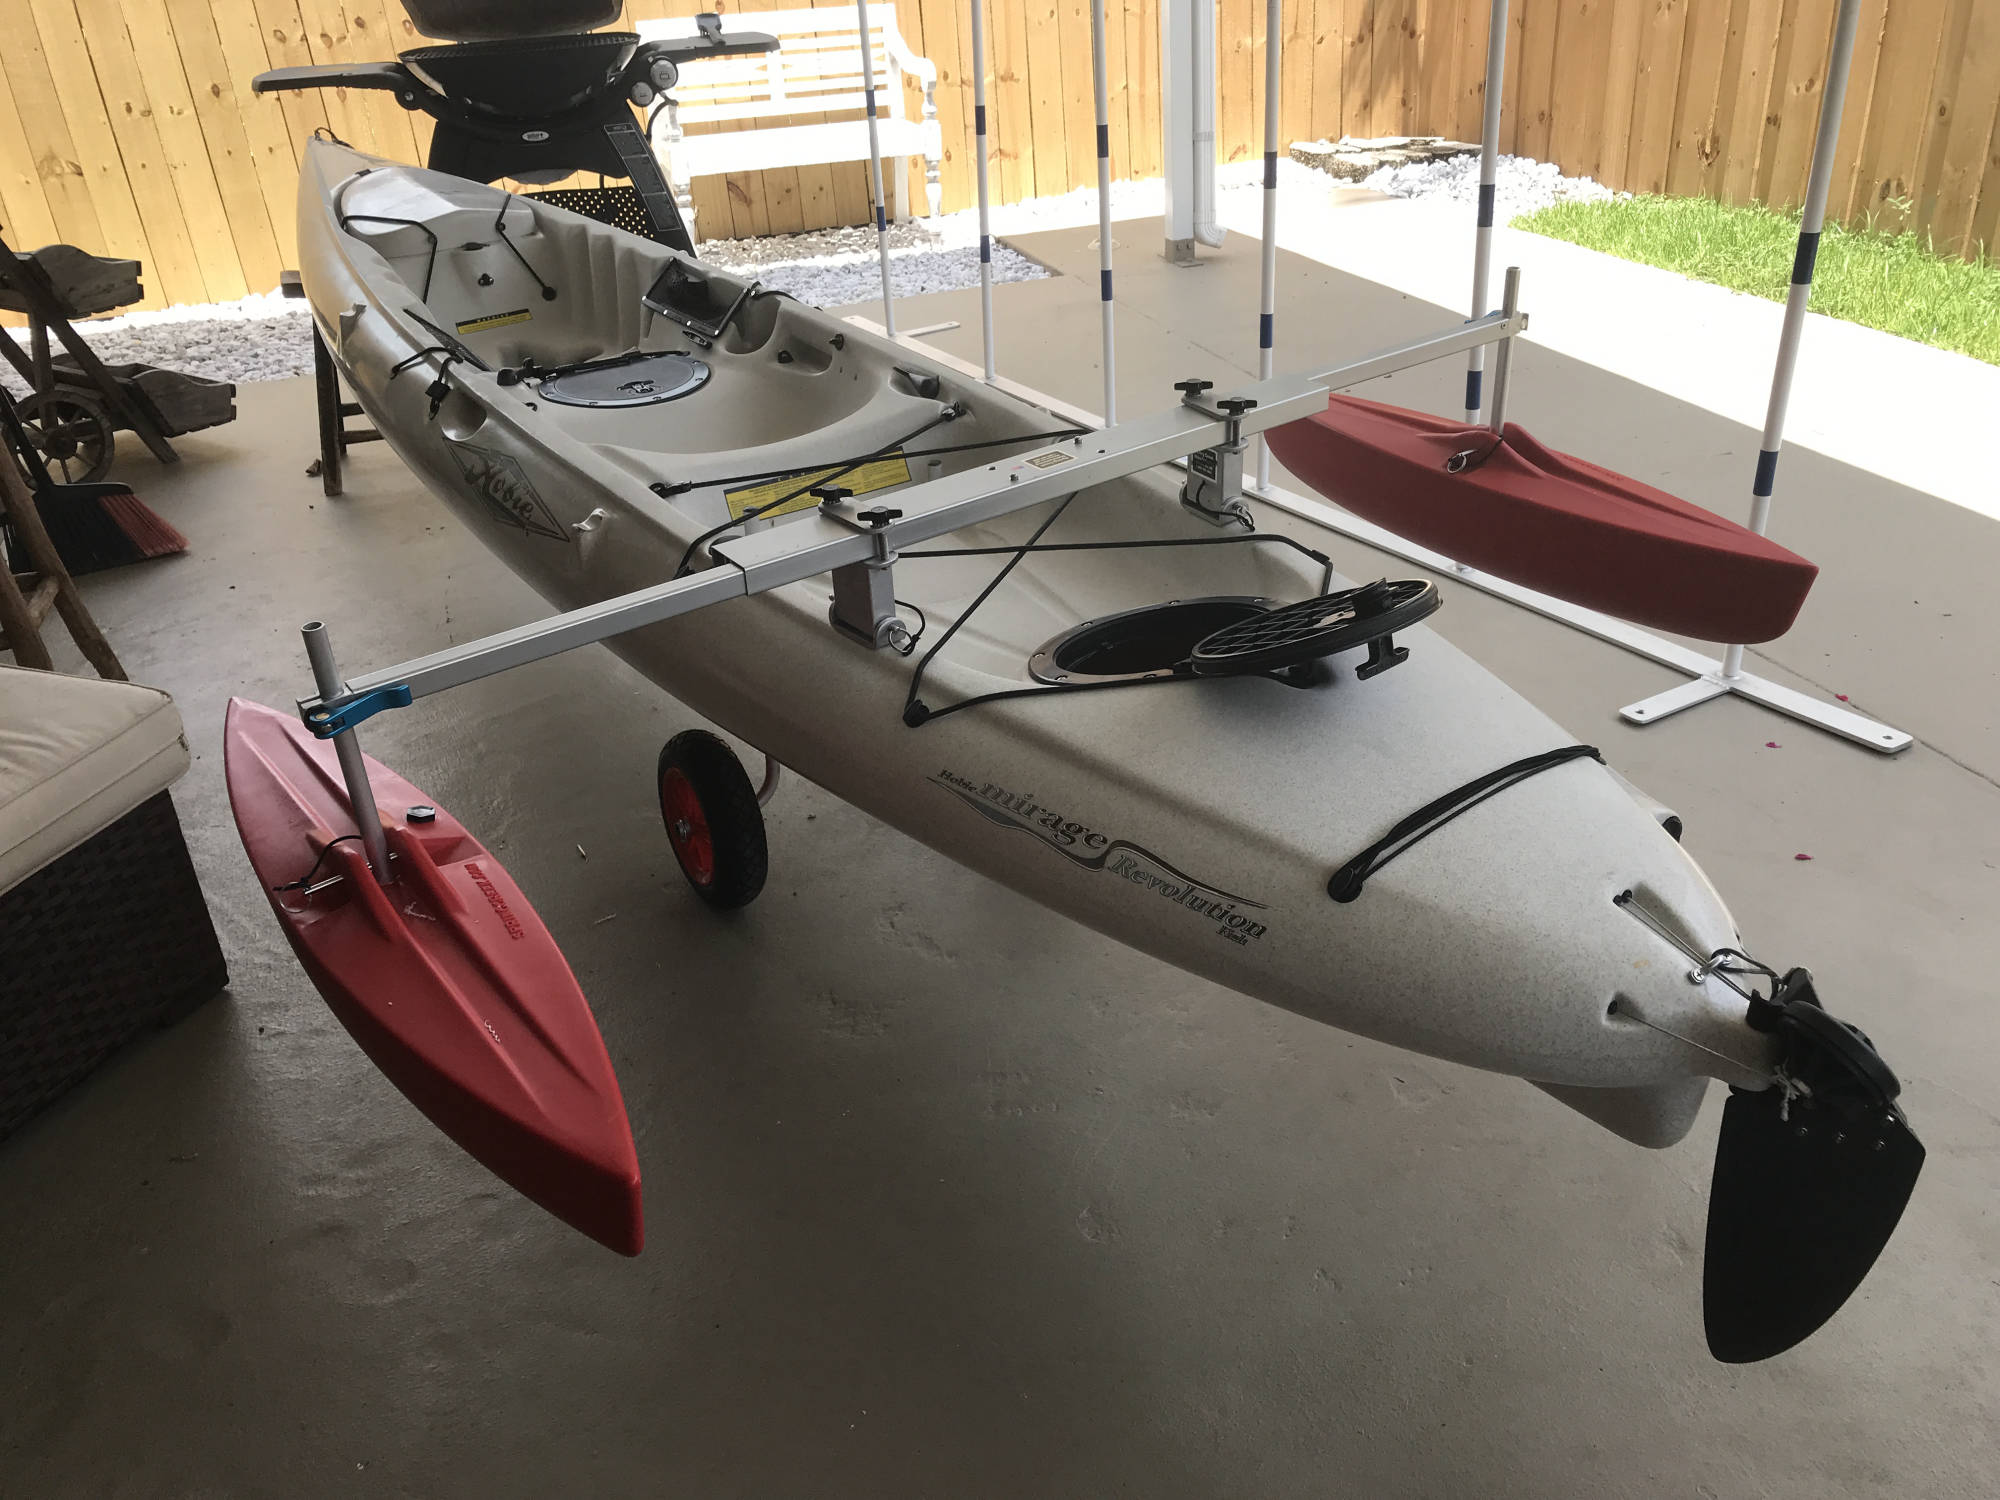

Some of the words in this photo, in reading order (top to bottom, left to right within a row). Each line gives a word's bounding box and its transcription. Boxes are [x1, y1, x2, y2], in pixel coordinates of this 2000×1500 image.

[937, 769, 978, 792] Hobie
[980, 782, 1108, 849] mirage
[1108, 854, 1267, 939] Revolution
